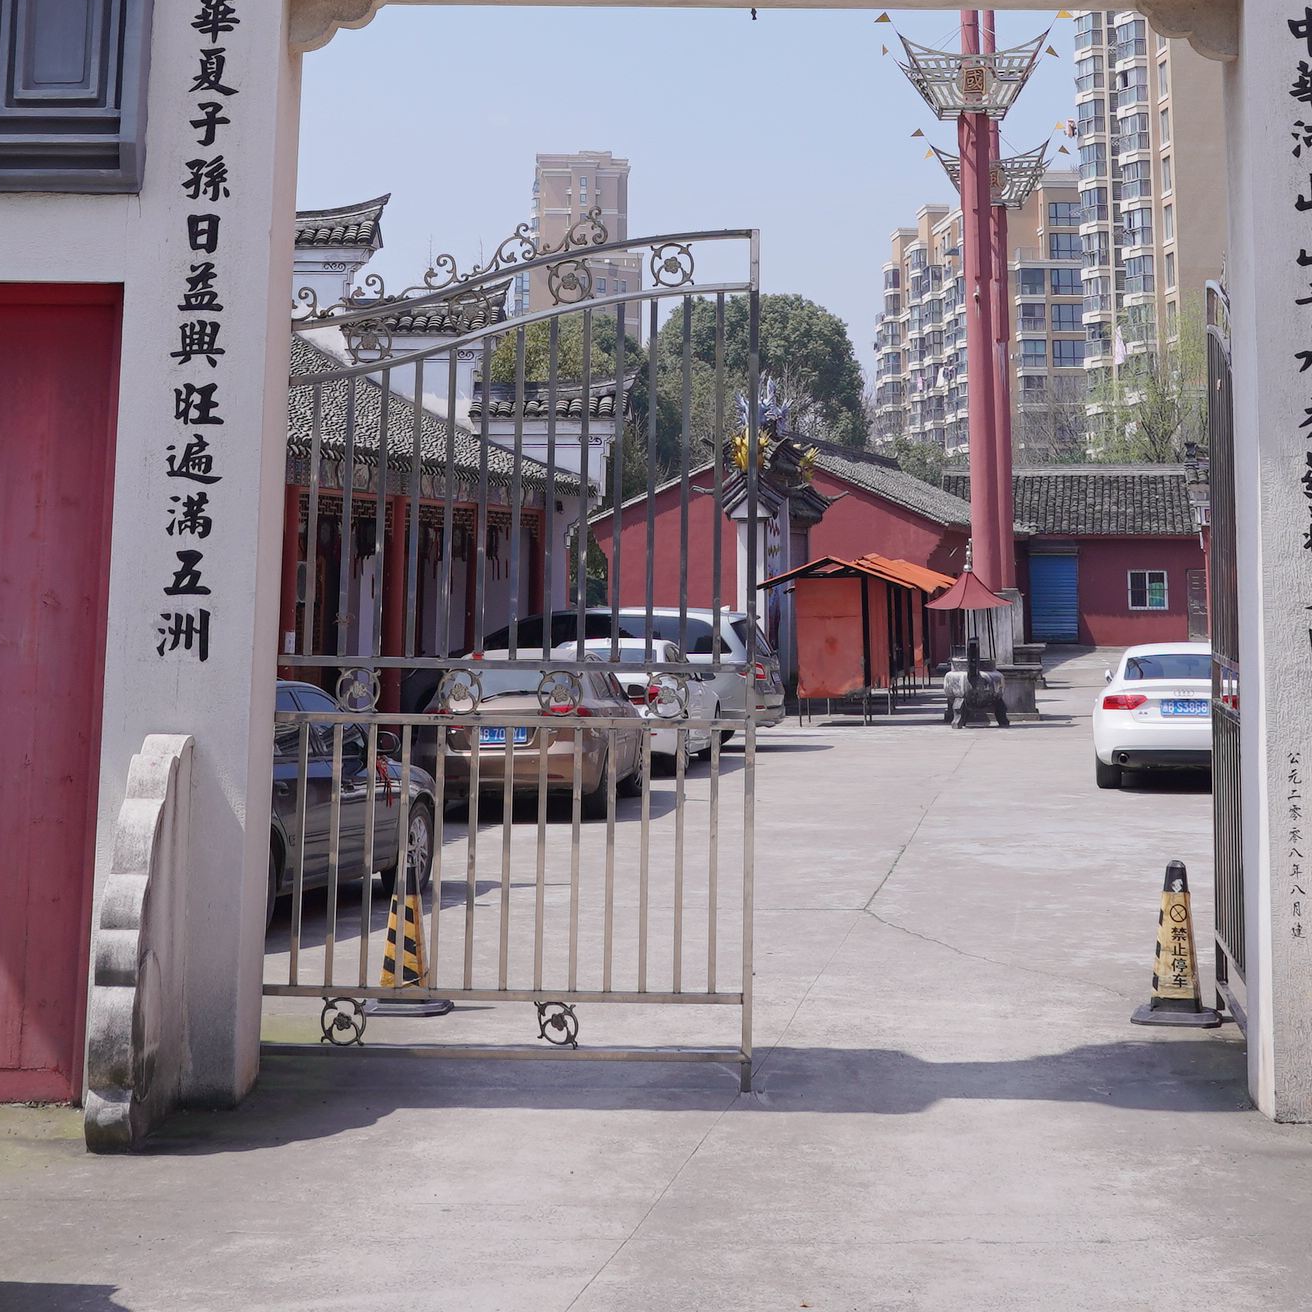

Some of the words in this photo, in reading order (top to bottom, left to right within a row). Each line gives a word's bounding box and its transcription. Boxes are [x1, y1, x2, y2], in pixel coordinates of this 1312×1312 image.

[962, 66, 989, 96] 國
[1171, 926, 1188, 989] 禁止停车
